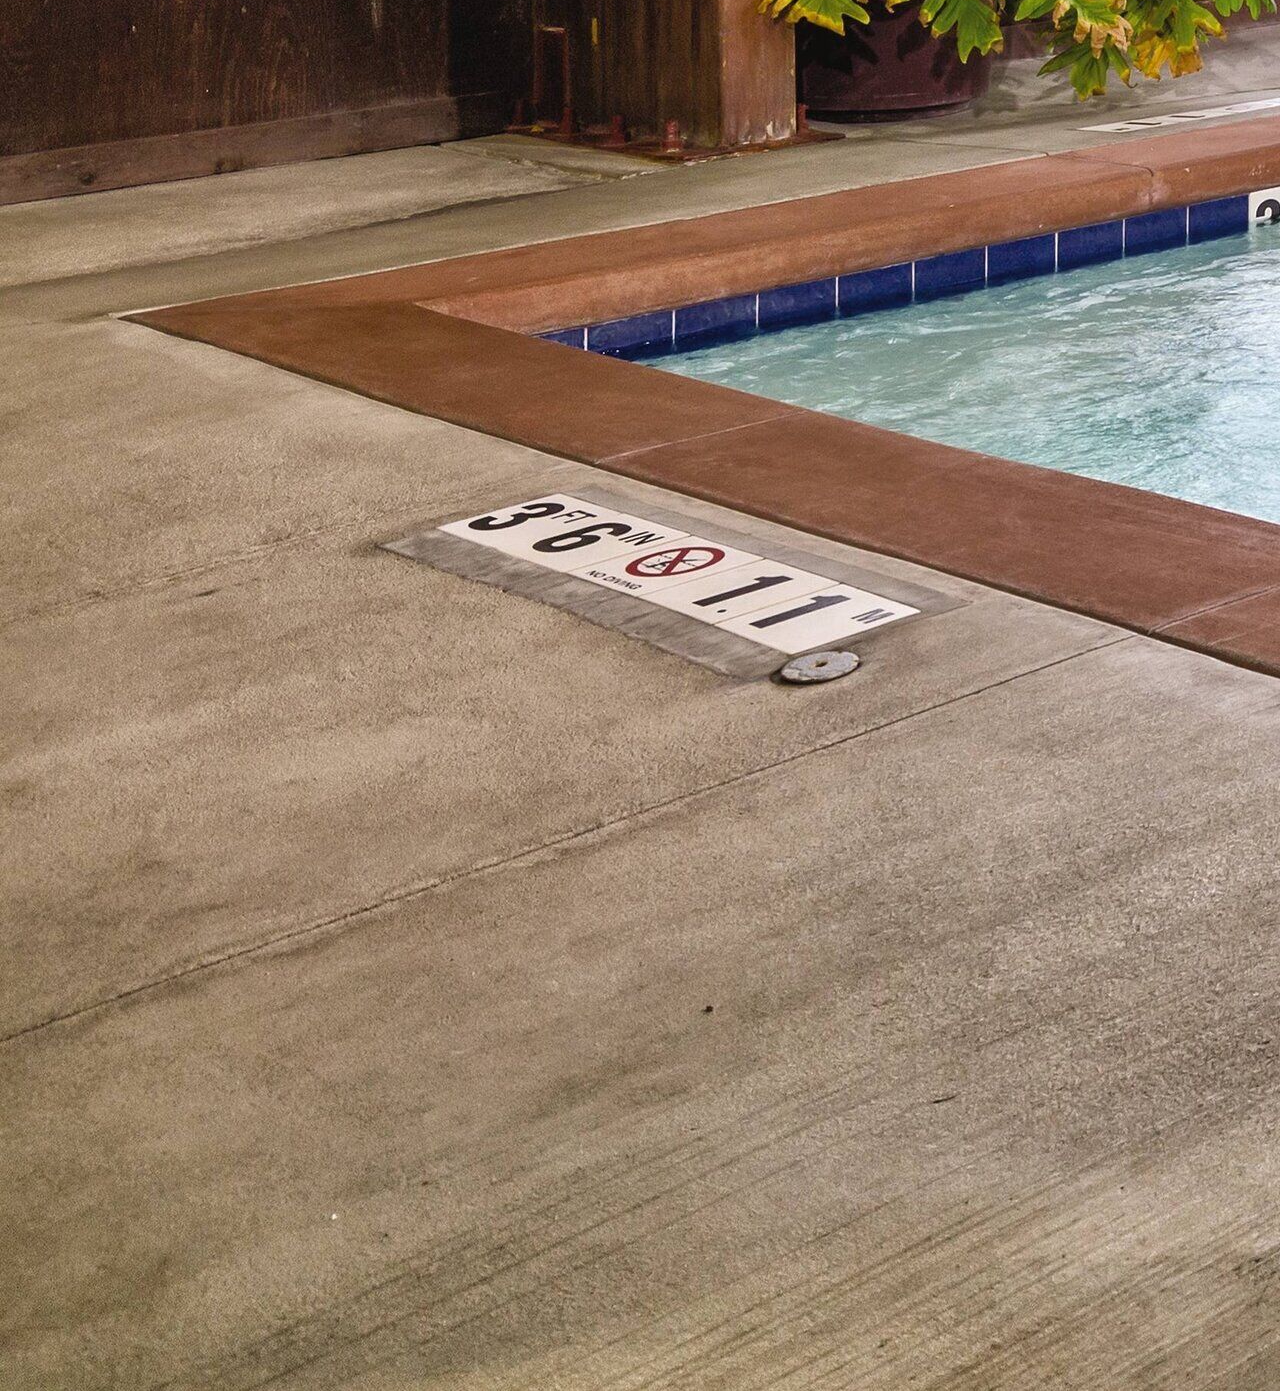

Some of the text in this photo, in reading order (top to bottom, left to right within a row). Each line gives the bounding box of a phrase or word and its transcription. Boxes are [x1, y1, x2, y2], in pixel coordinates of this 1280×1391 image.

[467, 502, 566, 531] 3
[551, 509, 598, 525] FT
[532, 522, 633, 553] 6
[618, 530, 666, 547] IN
[585, 570, 643, 590] NO DIVING
[851, 607, 896, 625] M
